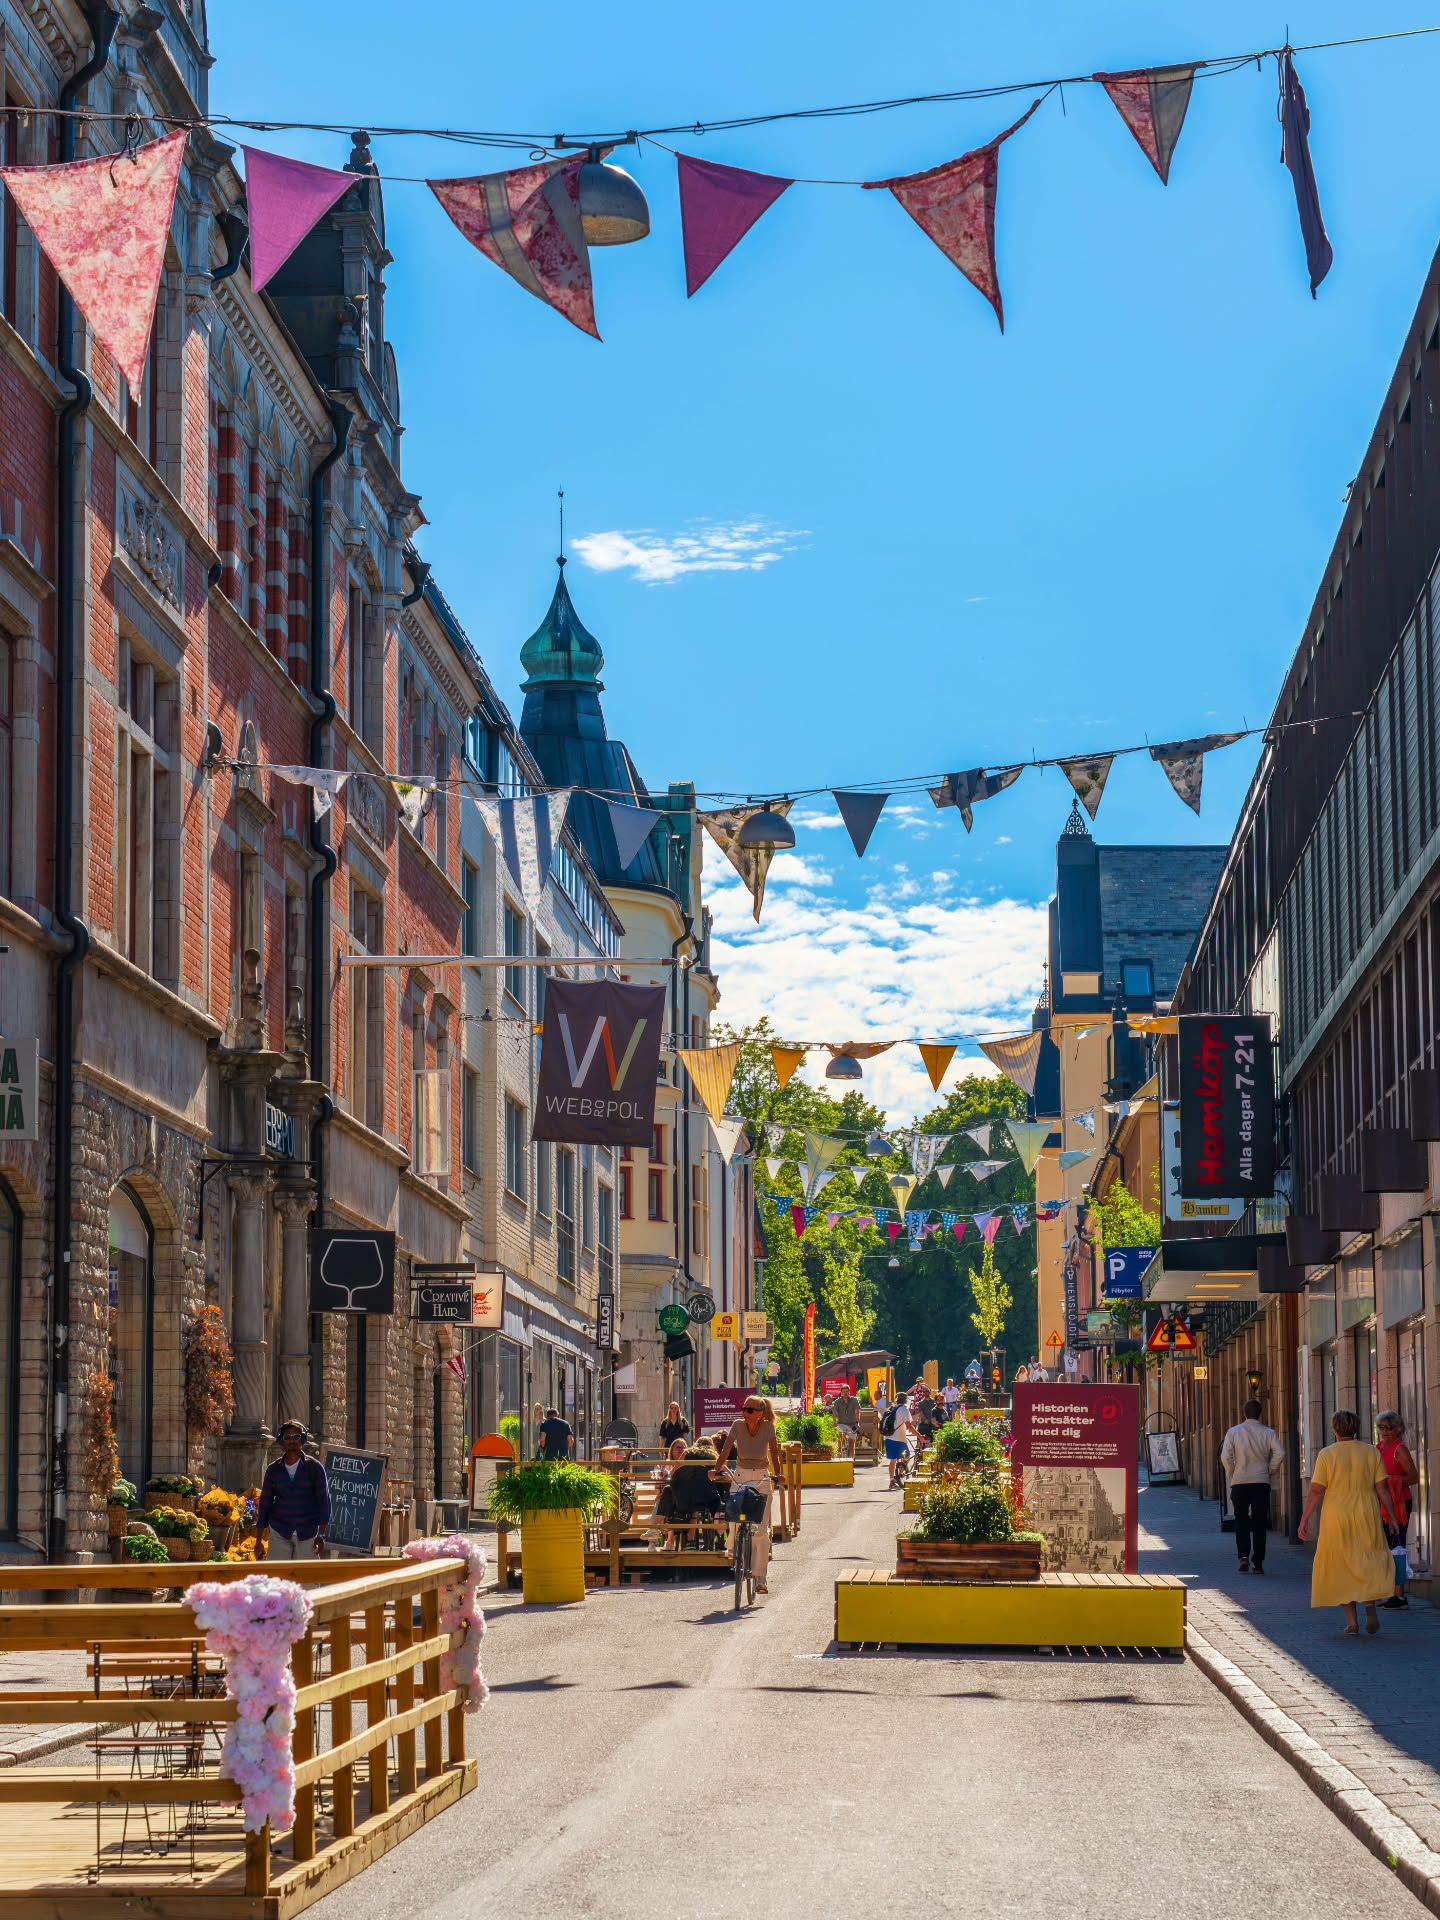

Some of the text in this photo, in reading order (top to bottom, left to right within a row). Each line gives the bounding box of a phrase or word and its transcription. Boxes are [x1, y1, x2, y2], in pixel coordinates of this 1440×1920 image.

[0, 1048, 20, 1083] A
[1195, 1024, 1229, 1185] Hemköp
[1235, 1035, 1254, 1180] Alla dagar 7-21
[1183, 1201, 1222, 1215] Hamlet
[1110, 1259, 1126, 1280] P
[421, 1289, 470, 1303] CREATIVE
[432, 1303, 466, 1319] HAIR
[600, 1298, 611, 1346] FOTEN
[1031, 1403, 1089, 1413] Historien
[1031, 1415, 1095, 1425] fortsätter
[1031, 1427, 1081, 1439] med dig
